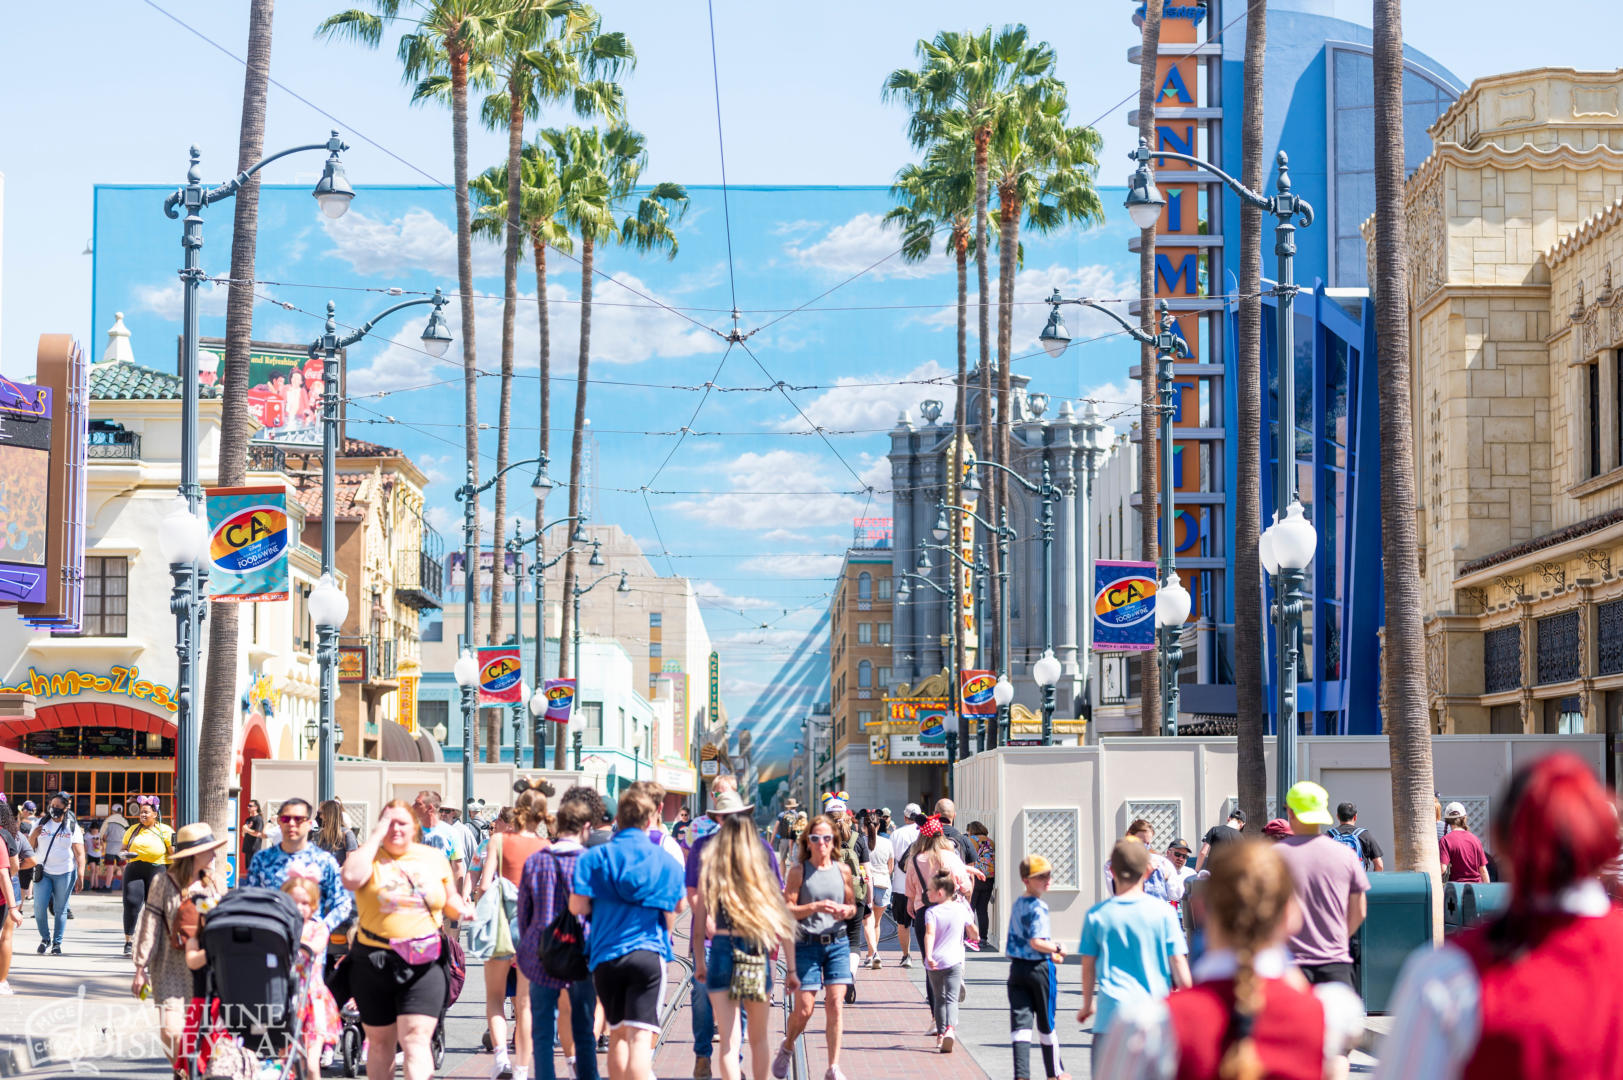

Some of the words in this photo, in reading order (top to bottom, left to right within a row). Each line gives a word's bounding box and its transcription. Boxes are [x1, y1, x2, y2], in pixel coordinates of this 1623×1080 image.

[225, 515, 273, 548] CA
[237, 554, 258, 569] FOOD
[262, 544, 280, 558] WINE
[1107, 583, 1144, 608] CA
[487, 660, 513, 679] CA
[549, 688, 568, 700] CA
[968, 679, 990, 694] CA
[924, 718, 941, 730] CA
